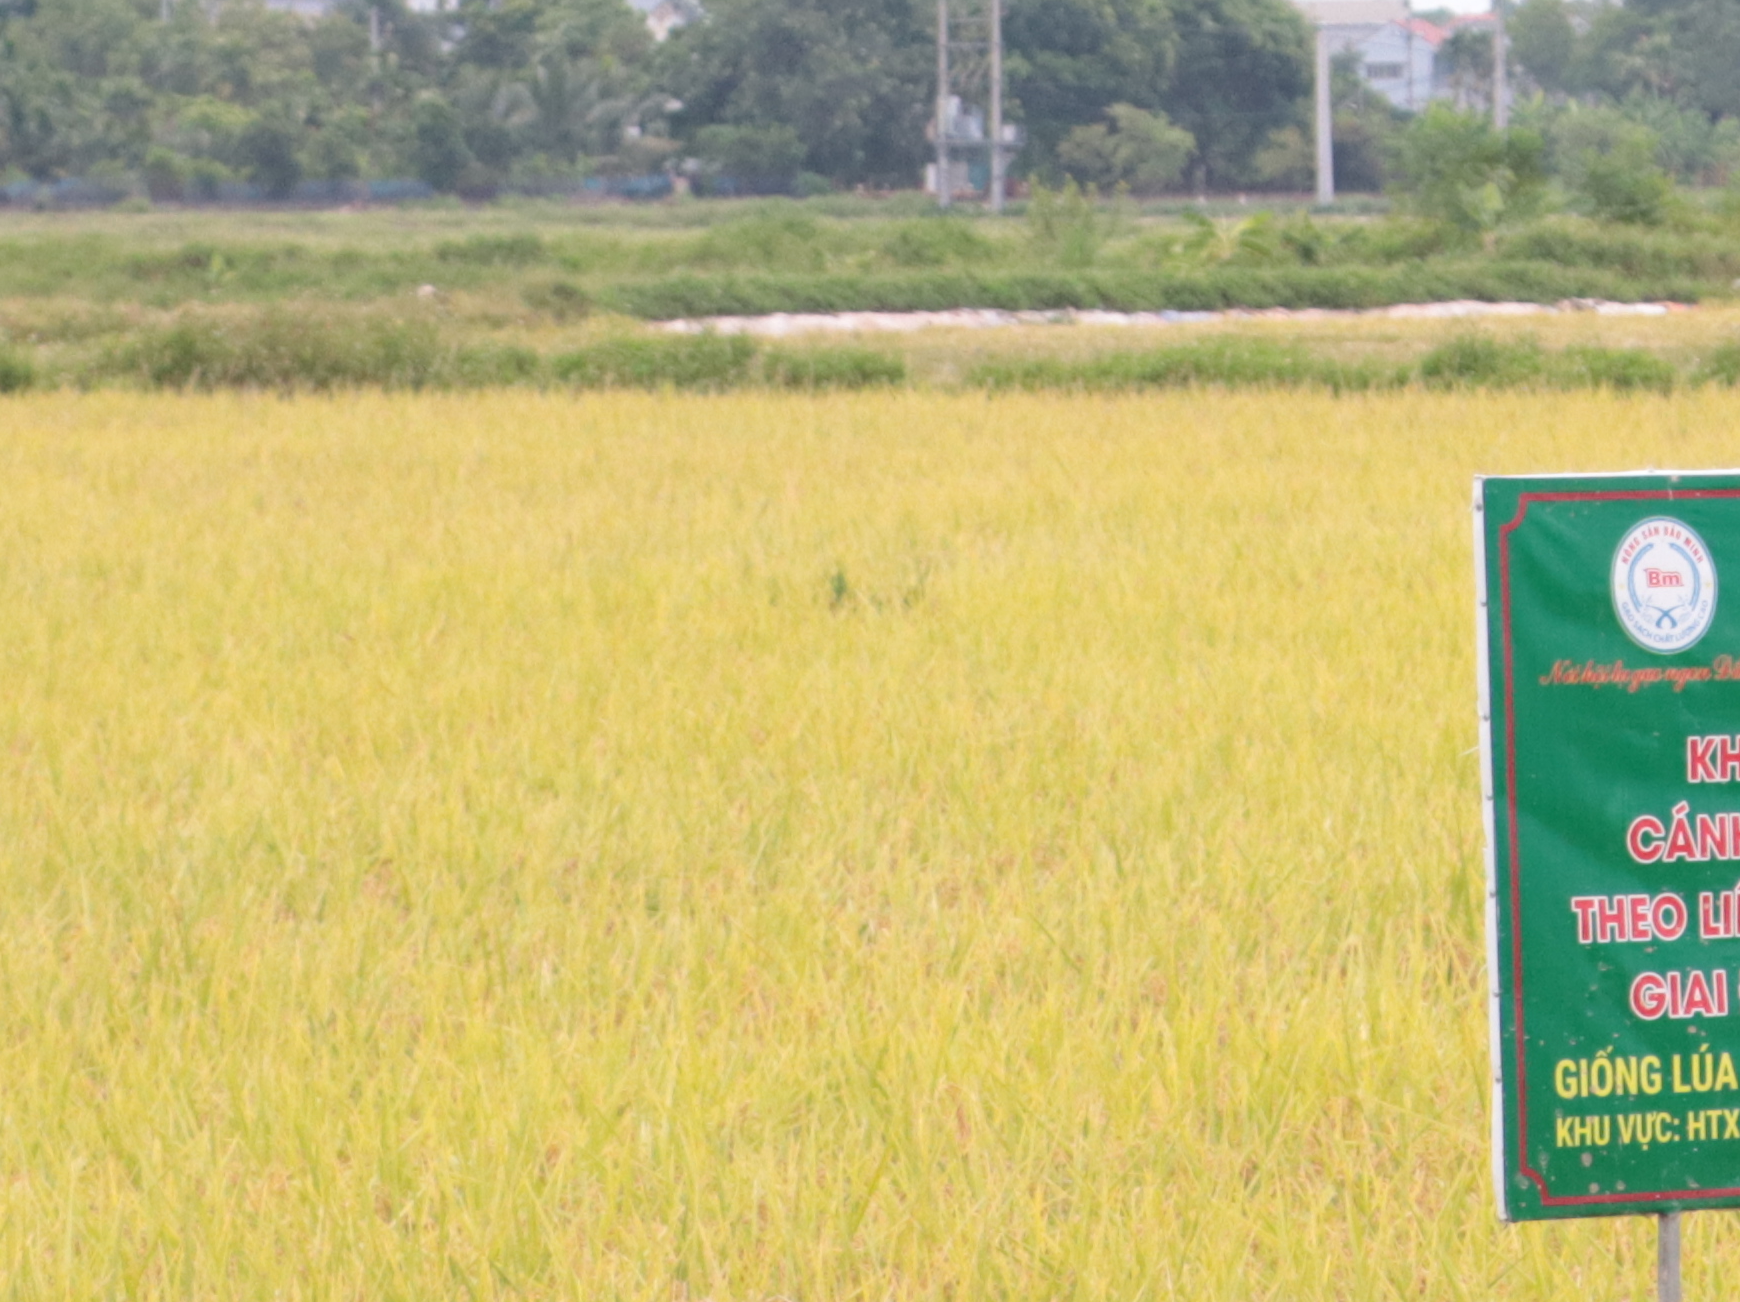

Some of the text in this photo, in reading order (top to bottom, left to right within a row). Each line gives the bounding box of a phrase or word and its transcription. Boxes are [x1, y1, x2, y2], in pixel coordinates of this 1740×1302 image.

[1621, 537, 1640, 564] NÔNG
[1684, 537, 1704, 563] MINH
[1571, 892, 1687, 944] THEO
[1629, 970, 1729, 1020] GIAI
[1555, 1045, 1662, 1099] GIỐNG
[1672, 1043, 1739, 1093] LÚA
[1556, 1115, 1610, 1147] KHU
[1617, 1110, 1680, 1151] VỰC:
[1687, 1108, 1740, 1140] HTX
